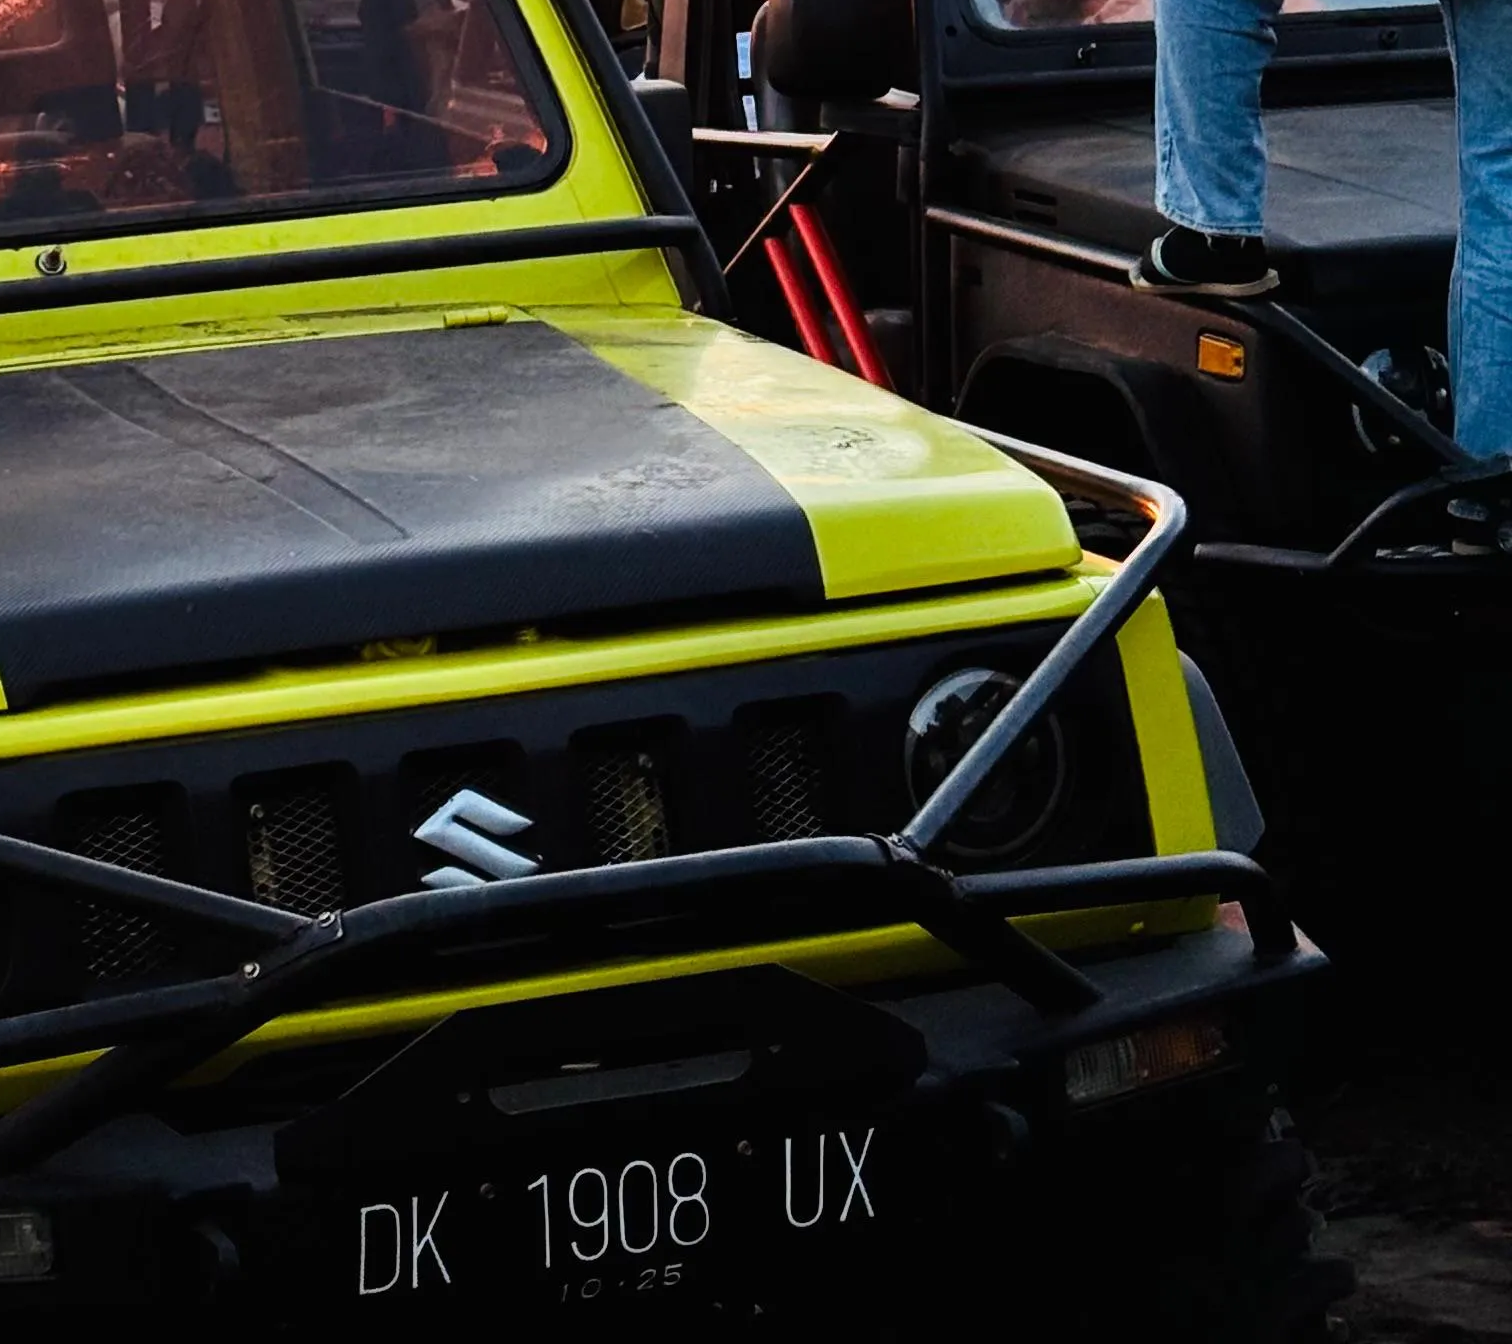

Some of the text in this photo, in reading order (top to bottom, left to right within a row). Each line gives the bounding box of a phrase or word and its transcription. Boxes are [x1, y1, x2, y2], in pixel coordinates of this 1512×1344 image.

[358, 1127, 876, 1296] DK 1908 UX
